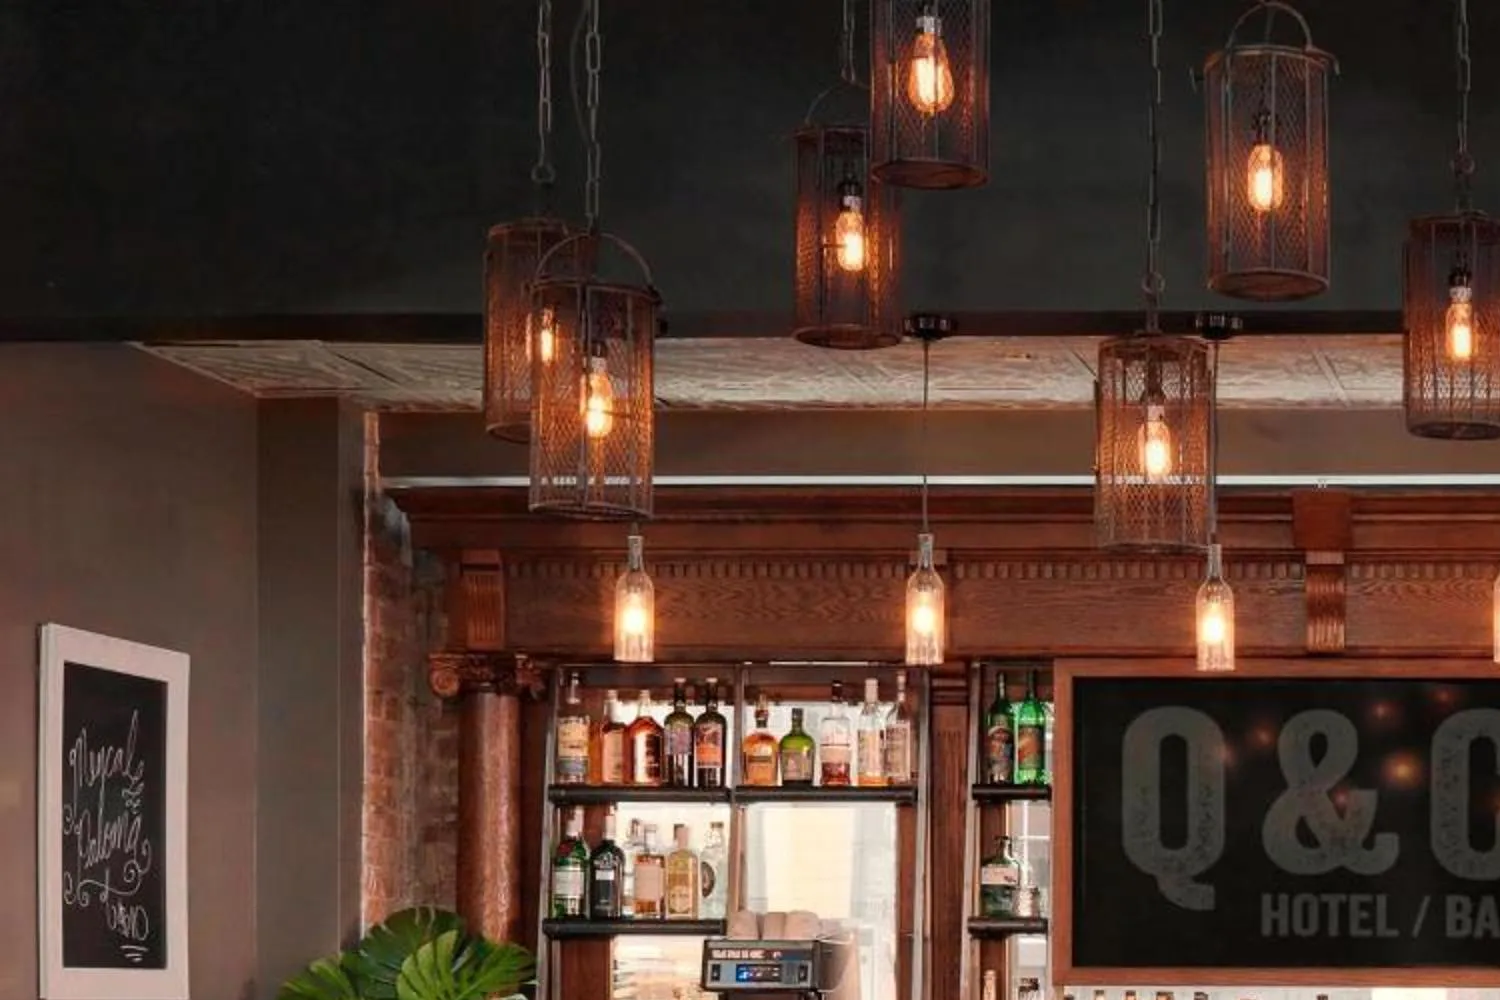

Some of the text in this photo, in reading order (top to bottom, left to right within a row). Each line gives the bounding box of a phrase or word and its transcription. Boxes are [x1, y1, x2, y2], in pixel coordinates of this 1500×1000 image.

[1122, 705, 1226, 911] Q
[1262, 708, 1400, 875] &
[1262, 893, 1398, 938] HOTEL
[1412, 893, 1429, 938] /
